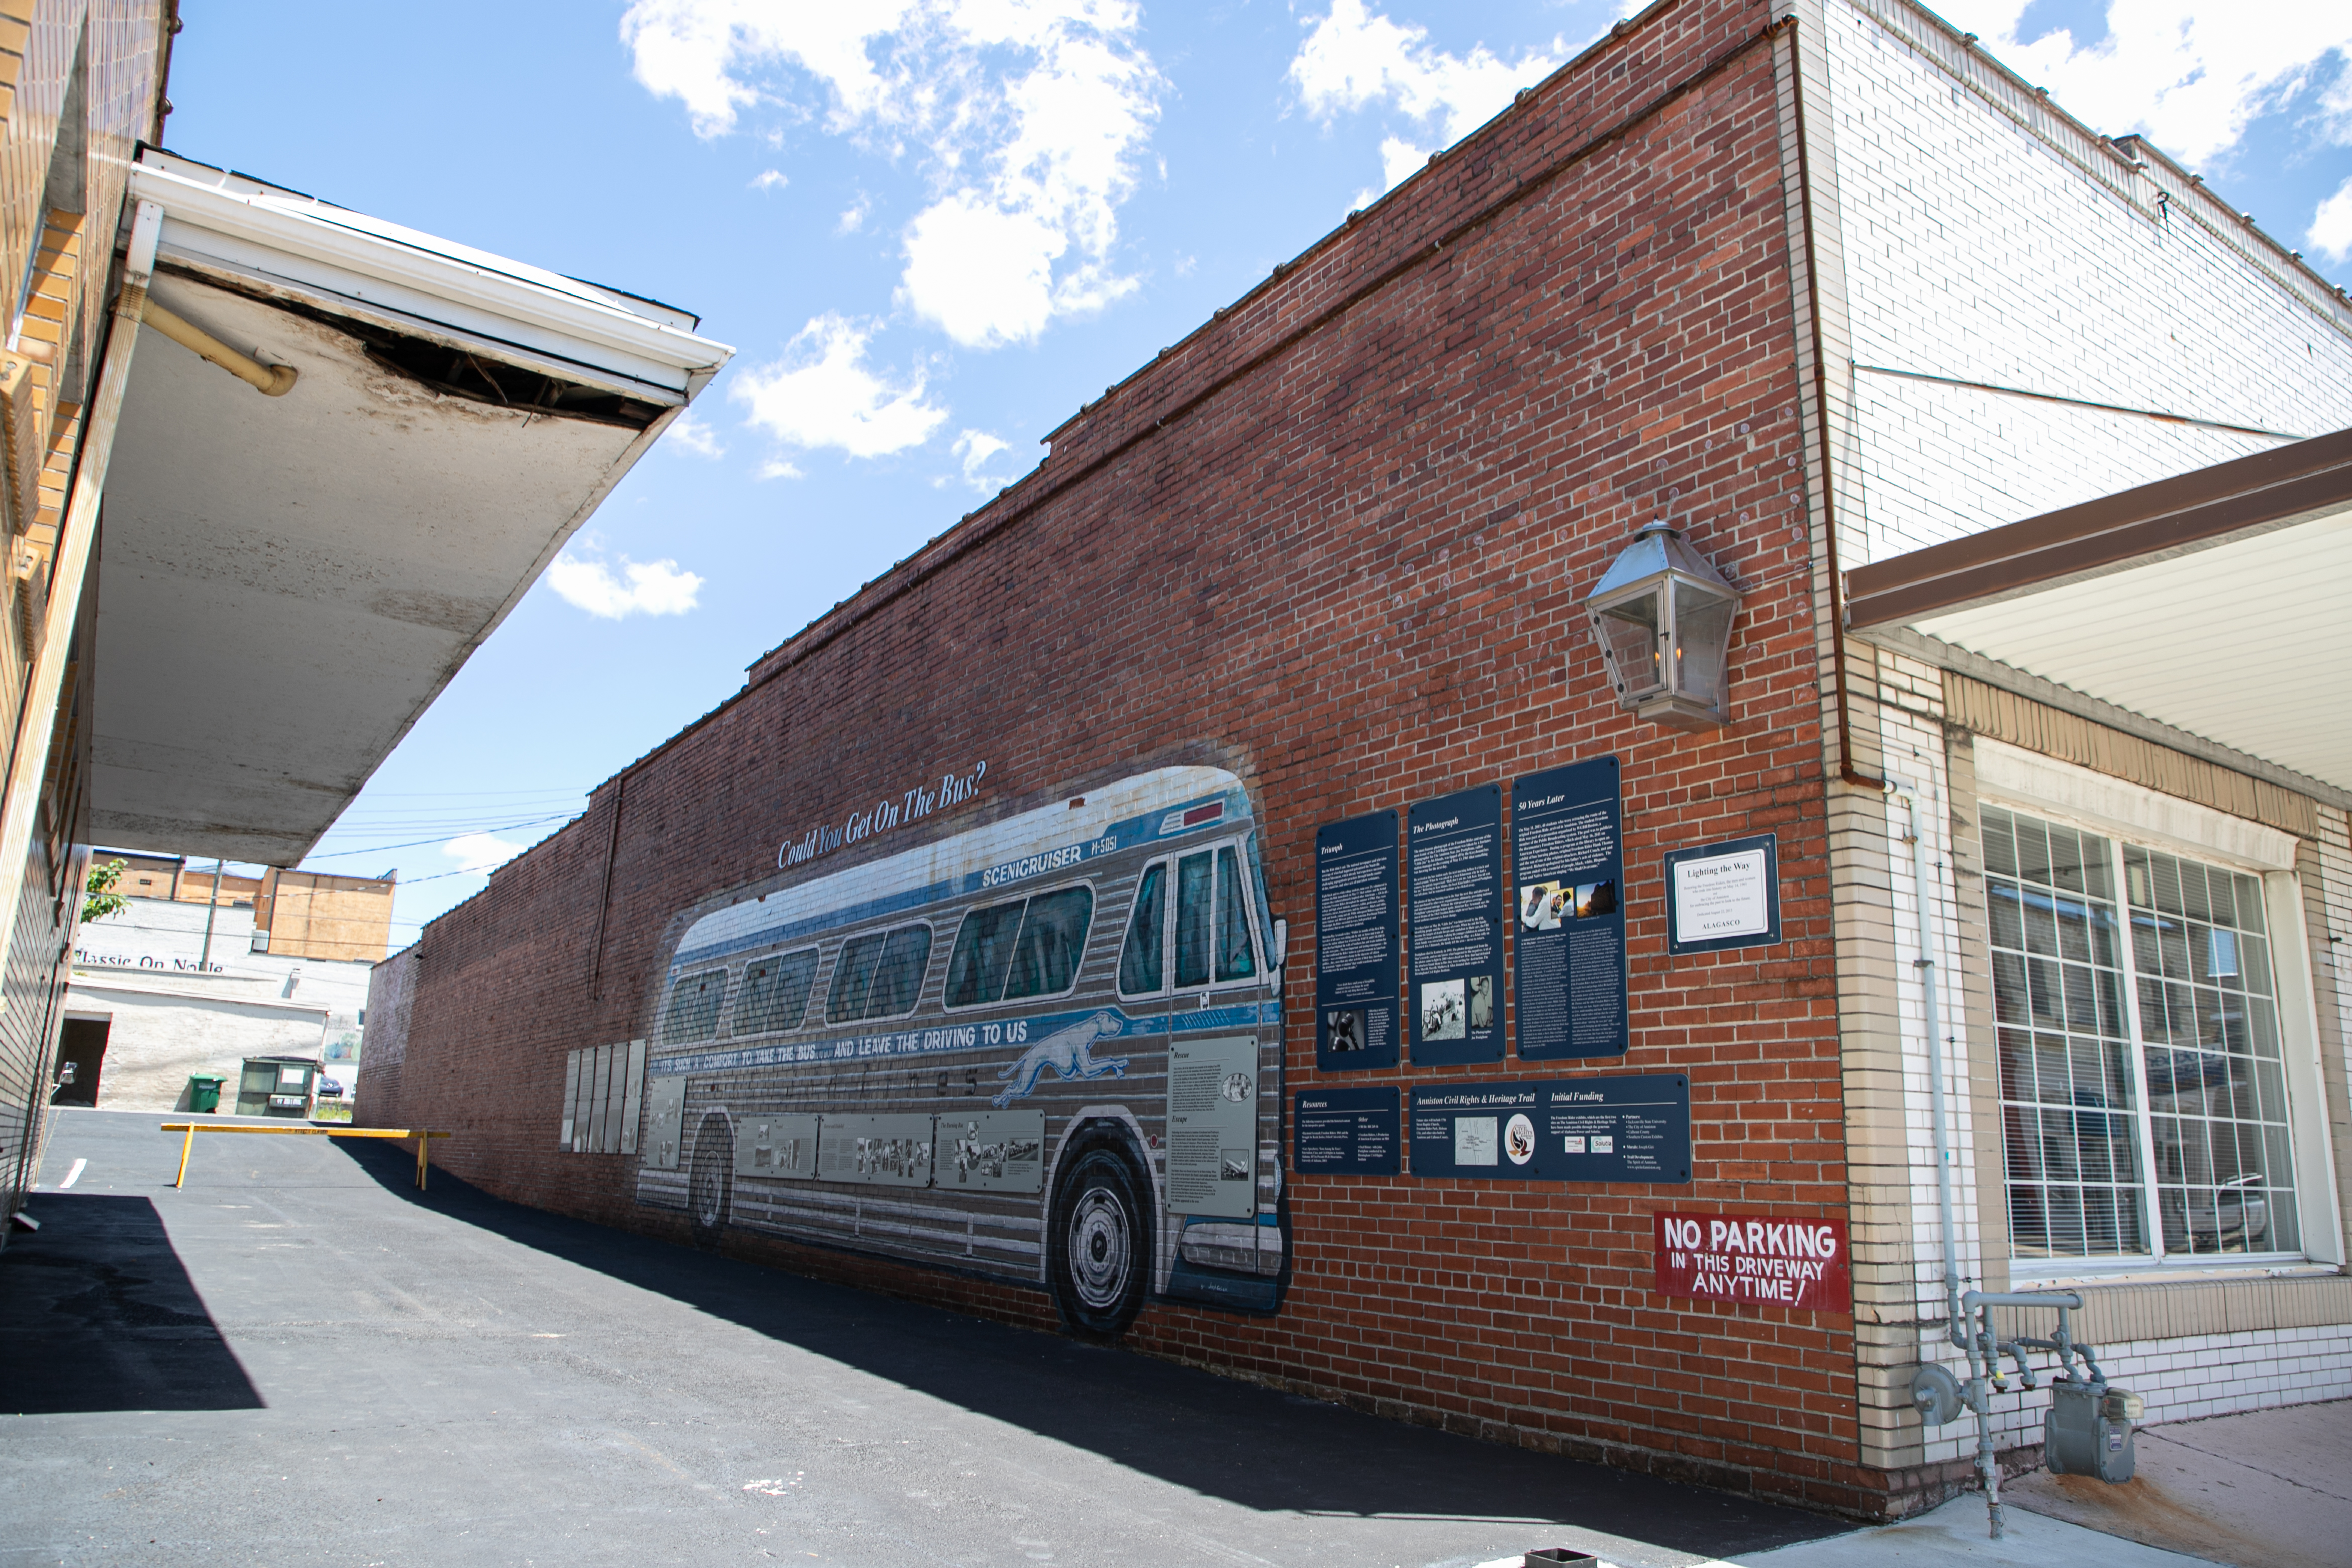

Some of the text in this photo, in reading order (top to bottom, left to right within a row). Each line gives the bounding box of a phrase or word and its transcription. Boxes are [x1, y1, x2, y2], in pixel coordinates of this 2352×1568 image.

[1518, 795, 1565, 811] 50 Years Later
[778, 760, 986, 869] Could You Get On The Bus?
[1413, 816, 1458, 834] The Photograph
[1321, 843, 1343, 855] Triumph
[983, 835, 1117, 887] SCENICRUISER M-5051
[1688, 862, 1750, 878] Lighting the Way
[1702, 919, 1740, 929] ALAGASCO
[140, 956, 164, 969] On
[174, 959, 223, 973] Nole
[675, 1057, 691, 1071] SUCH
[694, 1057, 699, 1069] A
[704, 1053, 738, 1068] COMFORT
[742, 1052, 752, 1065] TO
[756, 1047, 774, 1063] TAKE
[778, 1046, 793, 1061] THE
[834, 1041, 854, 1058] AND
[859, 1037, 891, 1055] LEAVE
[896, 1033, 919, 1052] THE
[924, 1027, 976, 1049] DRIVING
[983, 1023, 1000, 1044] TO
[1007, 1021, 1027, 1043] US
[1303, 1100, 1327, 1108] Resources
[1417, 1097, 1443, 1105] Anniston
[1444, 1095, 1458, 1104] Civil
[1459, 1095, 1480, 1106] Rights
[1489, 1094, 1517, 1105] Heritage
[1518, 1093, 1535, 1102] Trail
[1551, 1091, 1604, 1102] Initial Funding
[1172, 1115, 1187, 1124] Escape
[1664, 1218, 1836, 1258] NO PARKING
[1671, 1252, 1824, 1281] IN THIS DRIVEWAY
[1692, 1272, 1806, 1306] ANYTIME!
